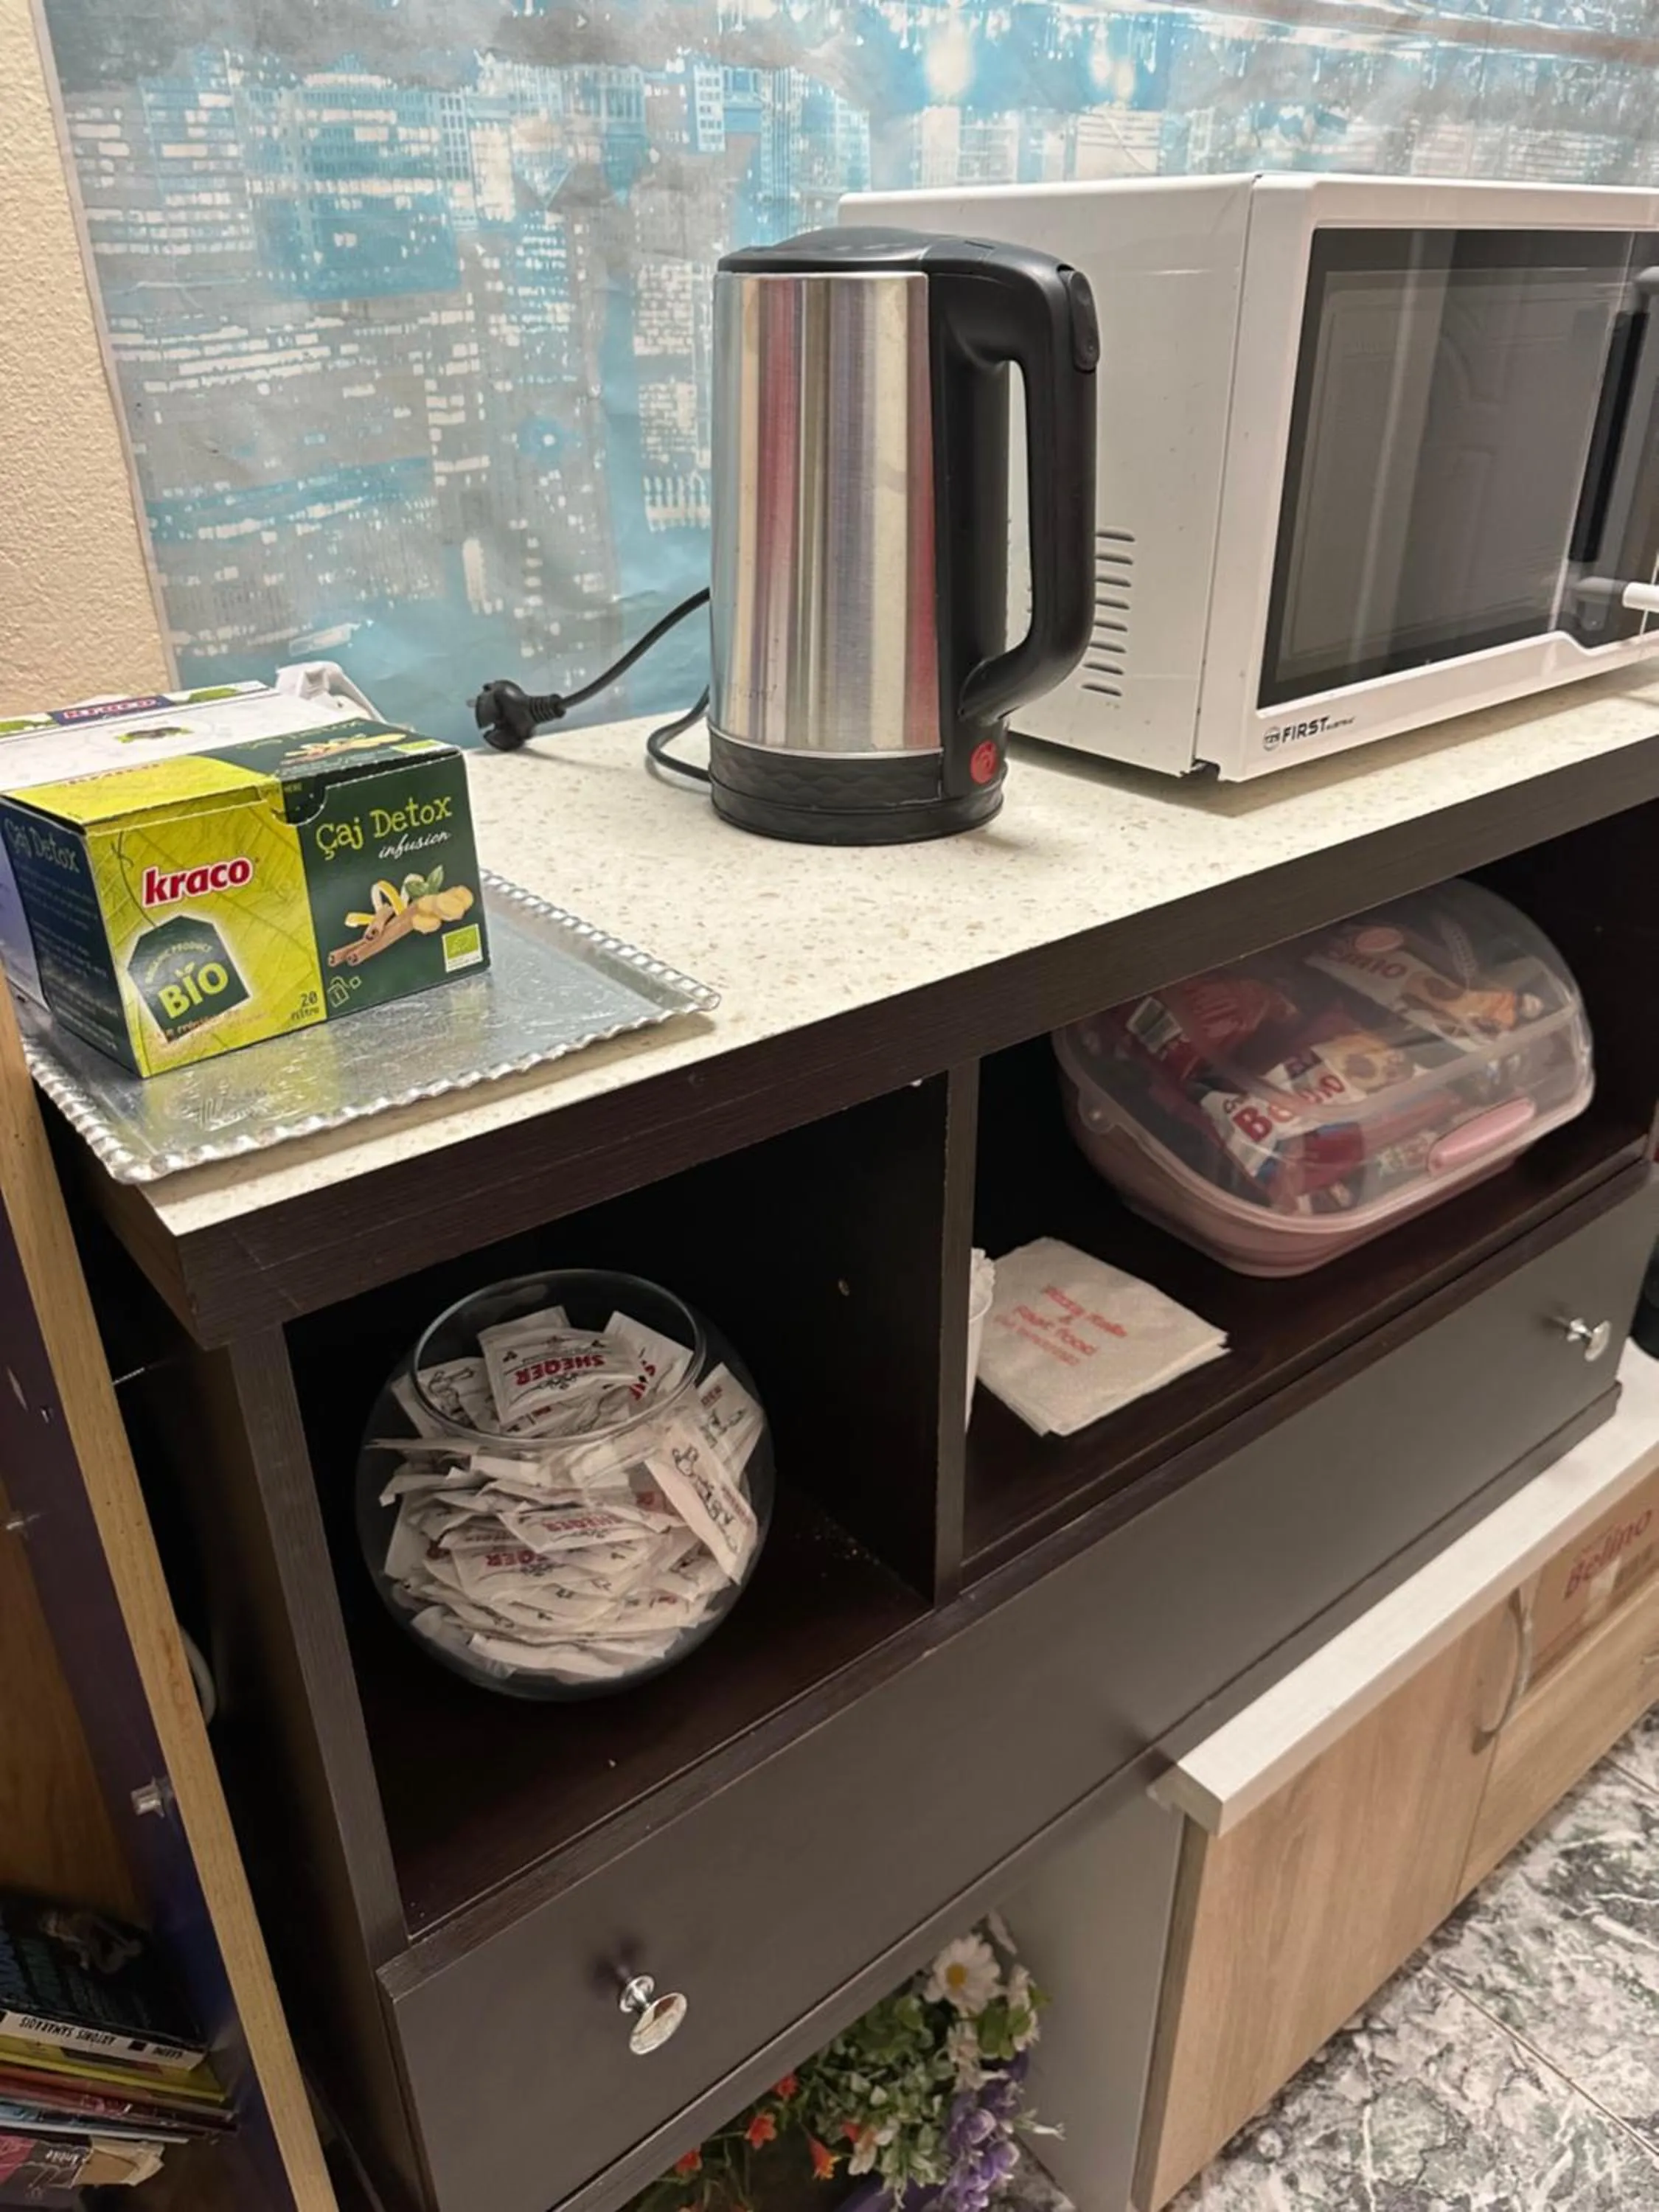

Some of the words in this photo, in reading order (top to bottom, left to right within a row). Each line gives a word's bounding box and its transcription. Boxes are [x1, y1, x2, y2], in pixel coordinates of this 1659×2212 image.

[1282, 714, 1330, 743] FIRST
[316, 816, 363, 860] Çaj
[370, 796, 453, 838] Detox
[379, 830, 450, 859] infusion
[144, 858, 251, 906] kraco
[300, 991, 318, 1007] 20
[515, 1354, 605, 1385] SHEQER
